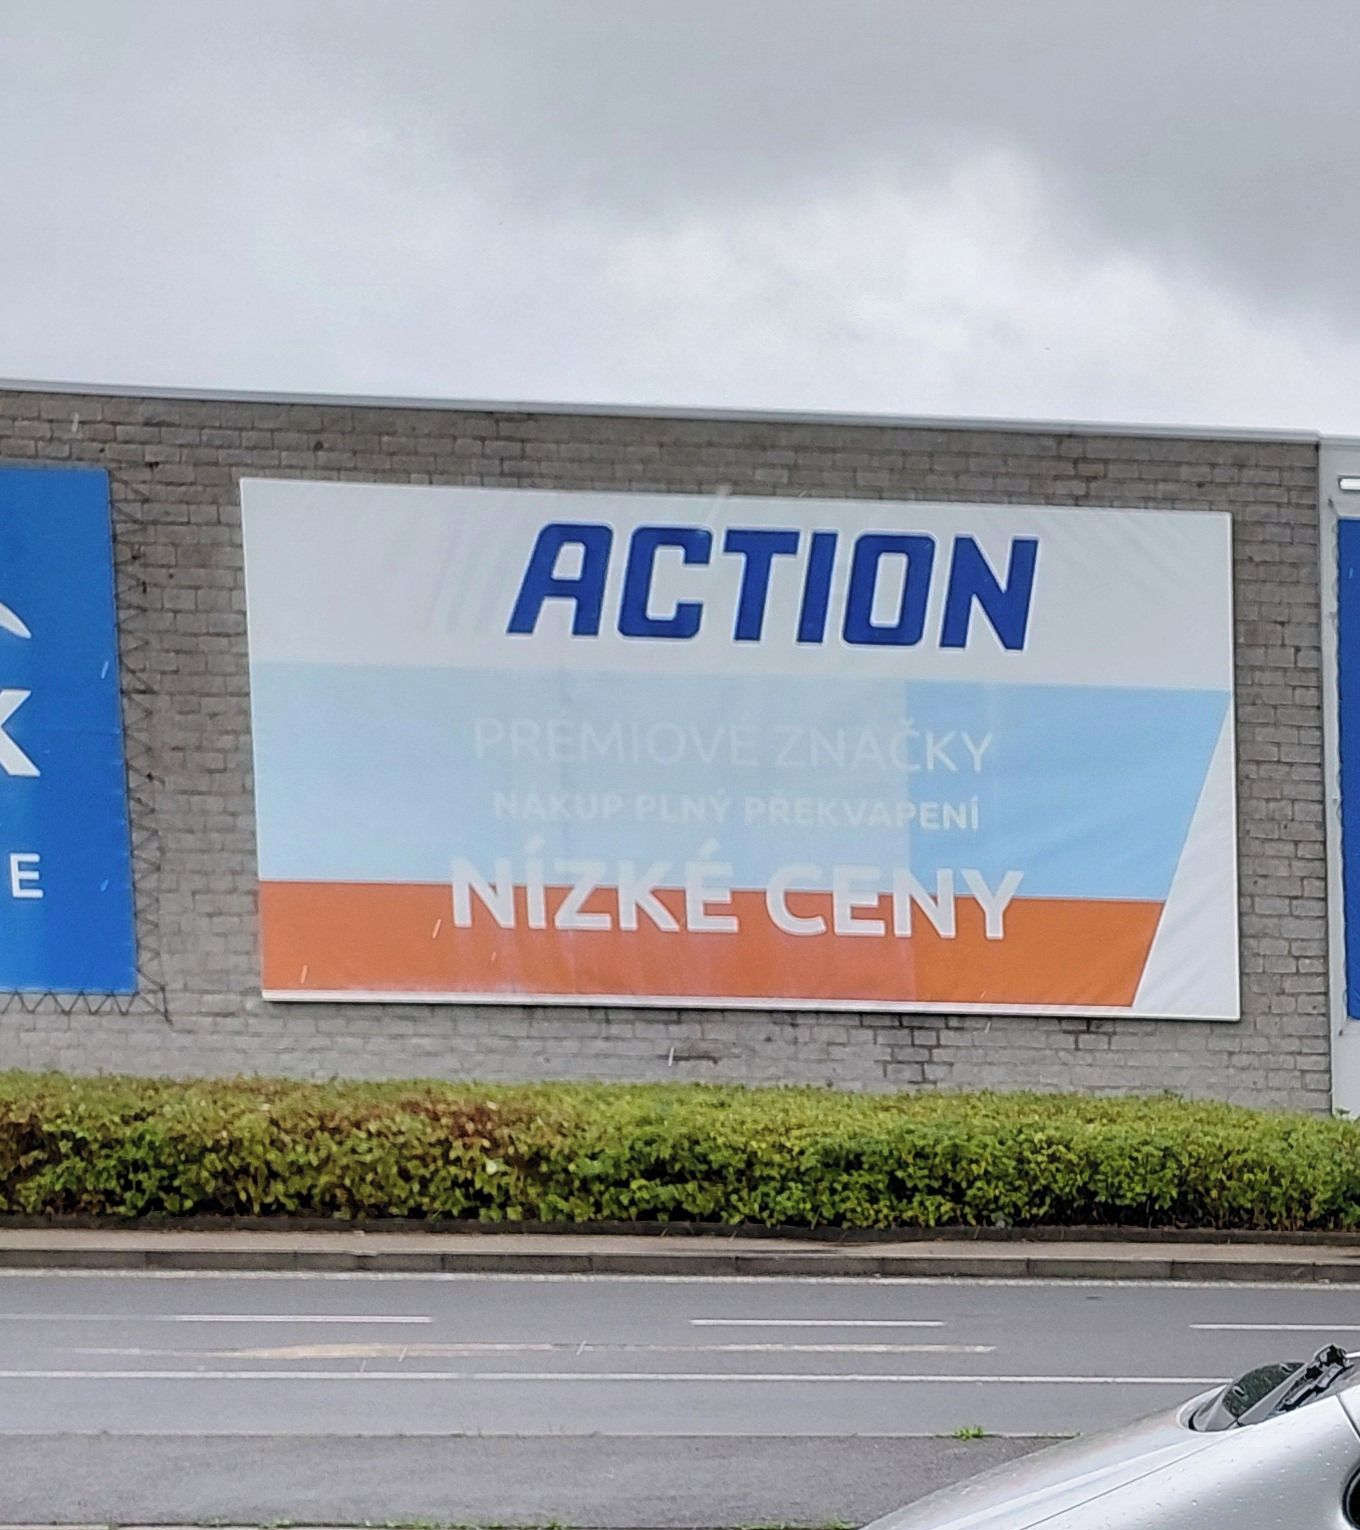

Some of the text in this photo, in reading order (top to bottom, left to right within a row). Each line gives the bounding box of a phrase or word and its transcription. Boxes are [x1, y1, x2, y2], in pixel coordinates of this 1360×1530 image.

[505, 521, 1040, 653] ACTION
[473, 709, 994, 774] PRÉMIOVÉ ZNAČKY
[492, 783, 980, 831] NÁKUP PLNÝ PŘEKVAPENÍ
[450, 835, 1026, 941] NÍZKÉ CENY
